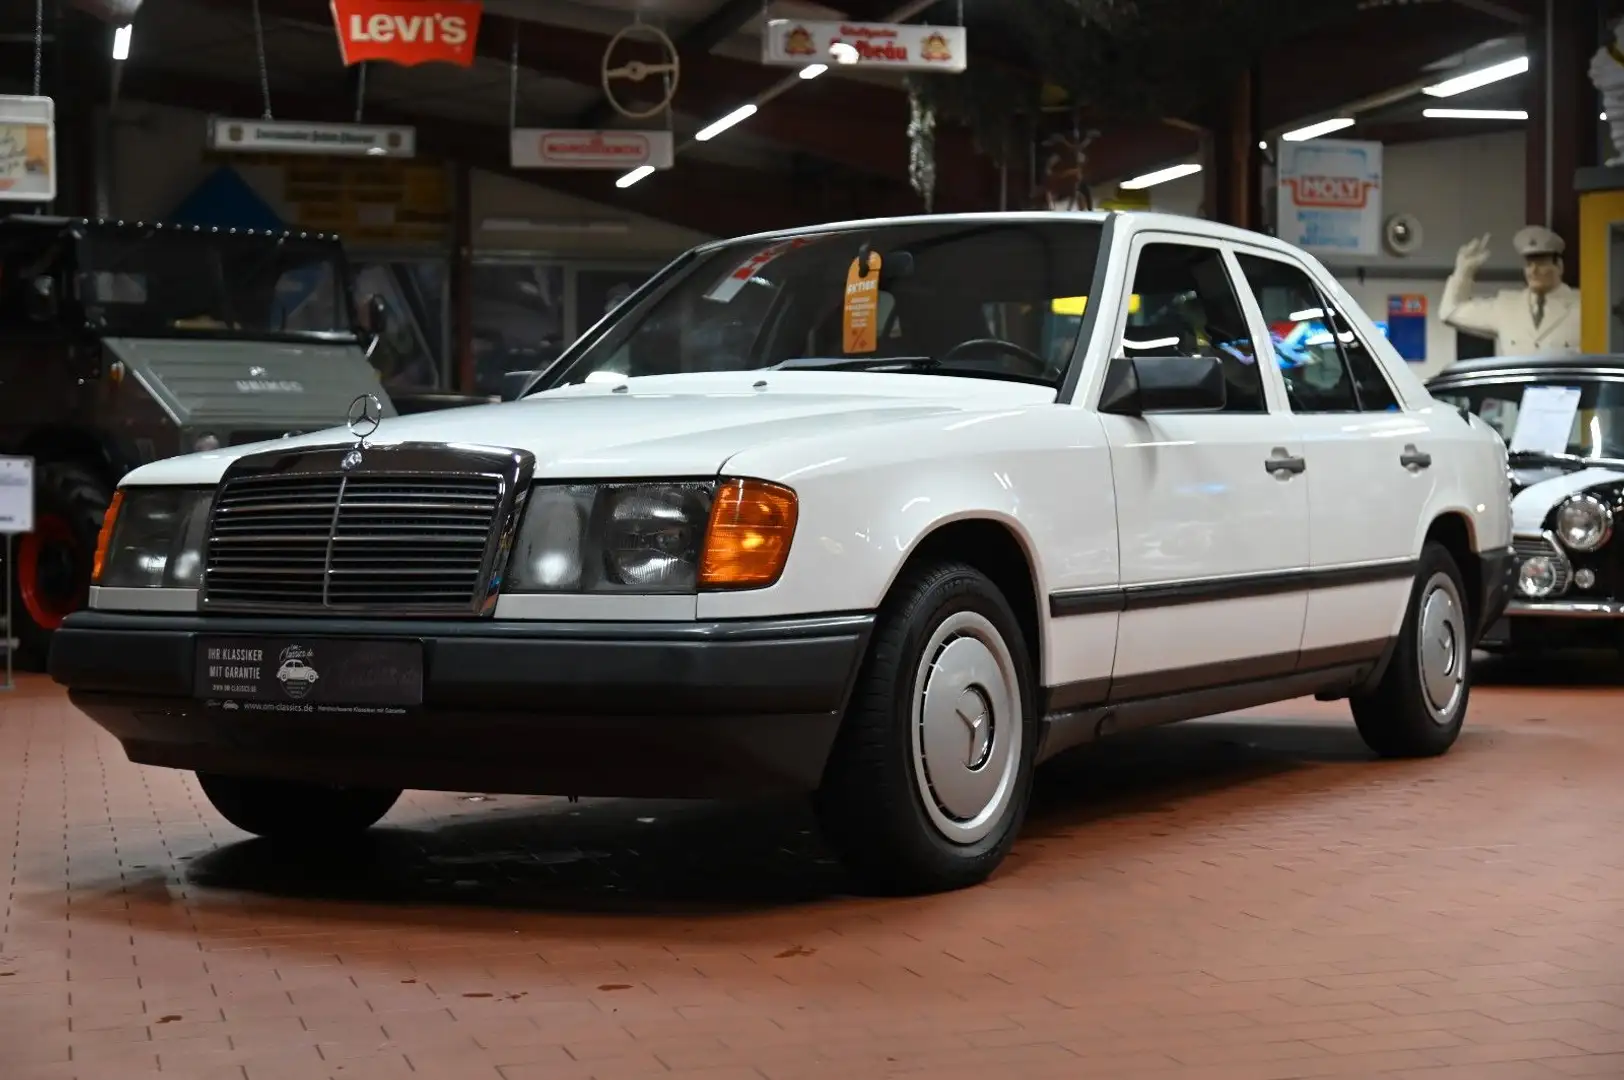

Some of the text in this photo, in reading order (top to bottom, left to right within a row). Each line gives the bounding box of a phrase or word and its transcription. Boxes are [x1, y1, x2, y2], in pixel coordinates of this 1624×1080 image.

[1303, 178, 1358, 198] MOLY
[207, 648, 263, 661] IHR KLASSIKER
[209, 666, 261, 680] MIT GARANTIE
[244, 703, 313, 713] www.om-classics.de
